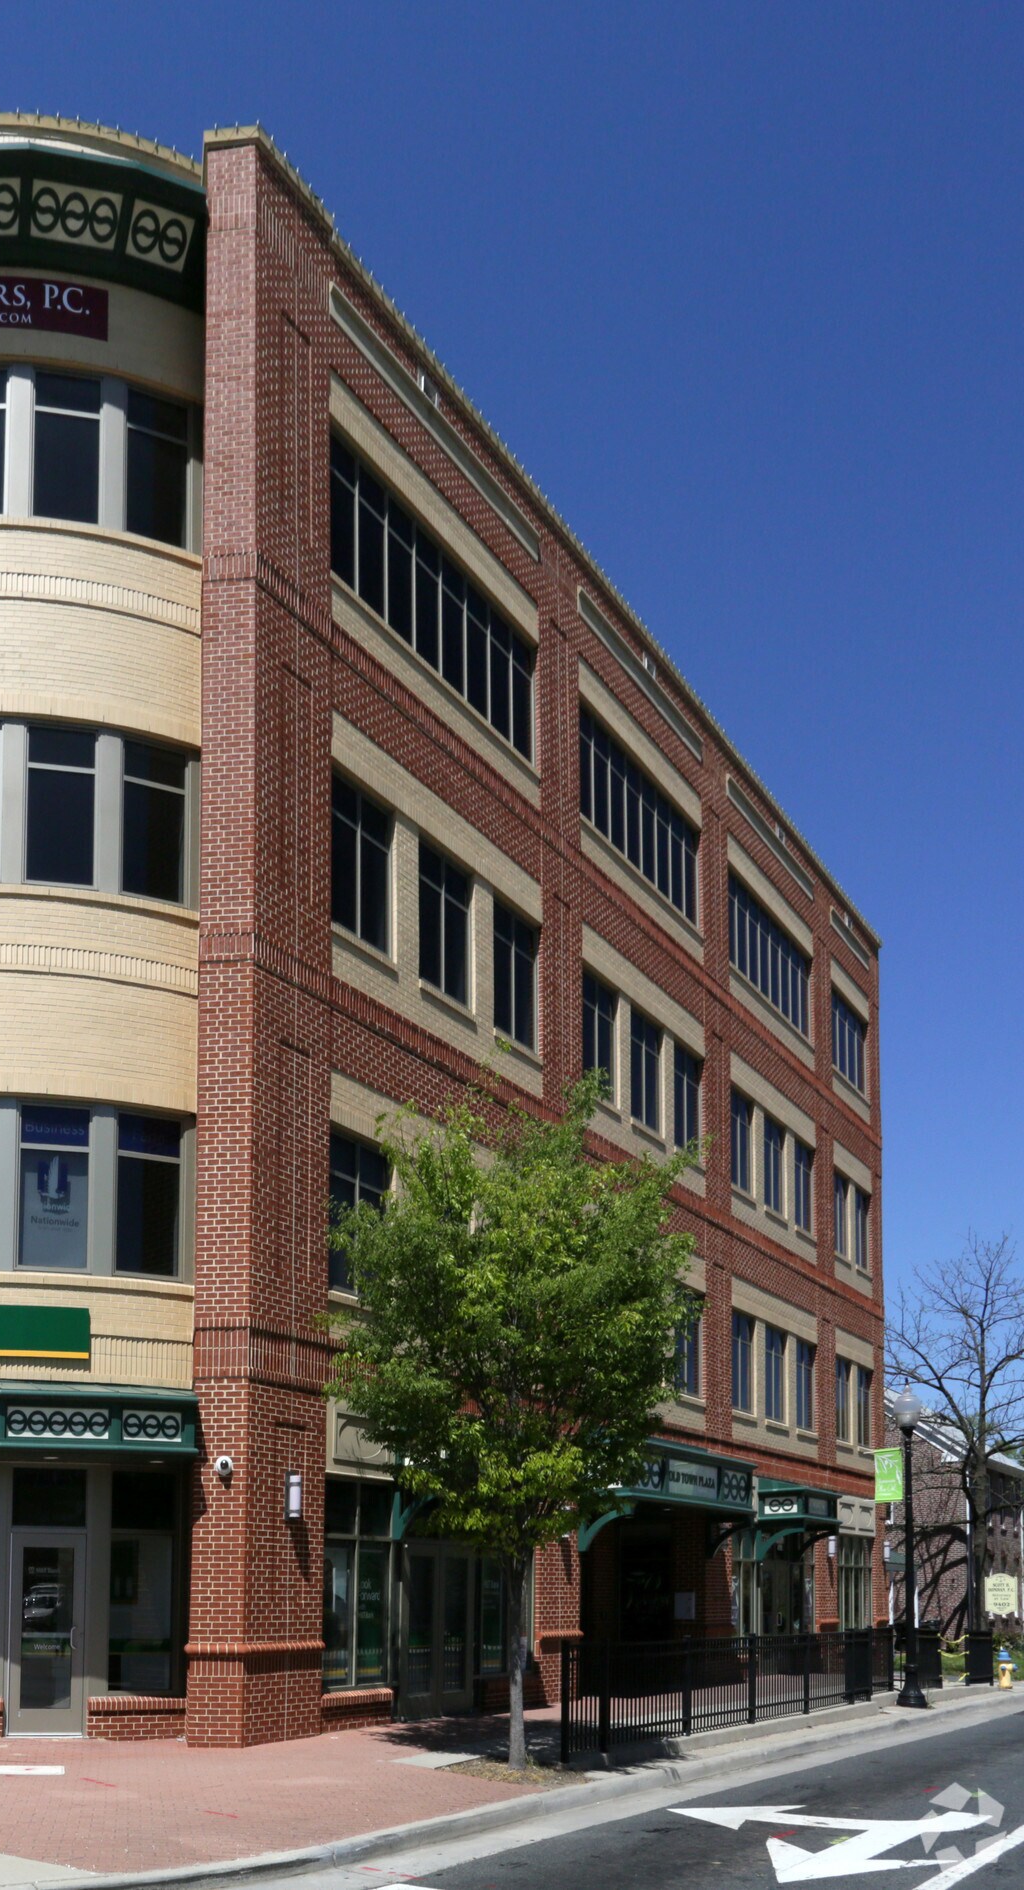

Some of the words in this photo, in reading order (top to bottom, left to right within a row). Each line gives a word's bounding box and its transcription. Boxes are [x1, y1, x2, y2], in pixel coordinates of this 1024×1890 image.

[43, 284, 90, 316] P.C.
[25, 1122, 85, 1135] Business
[30, 1215, 80, 1227] Nationwide
[681, 1473, 698, 1486] TOWN
[699, 1476, 716, 1489] PLAZA
